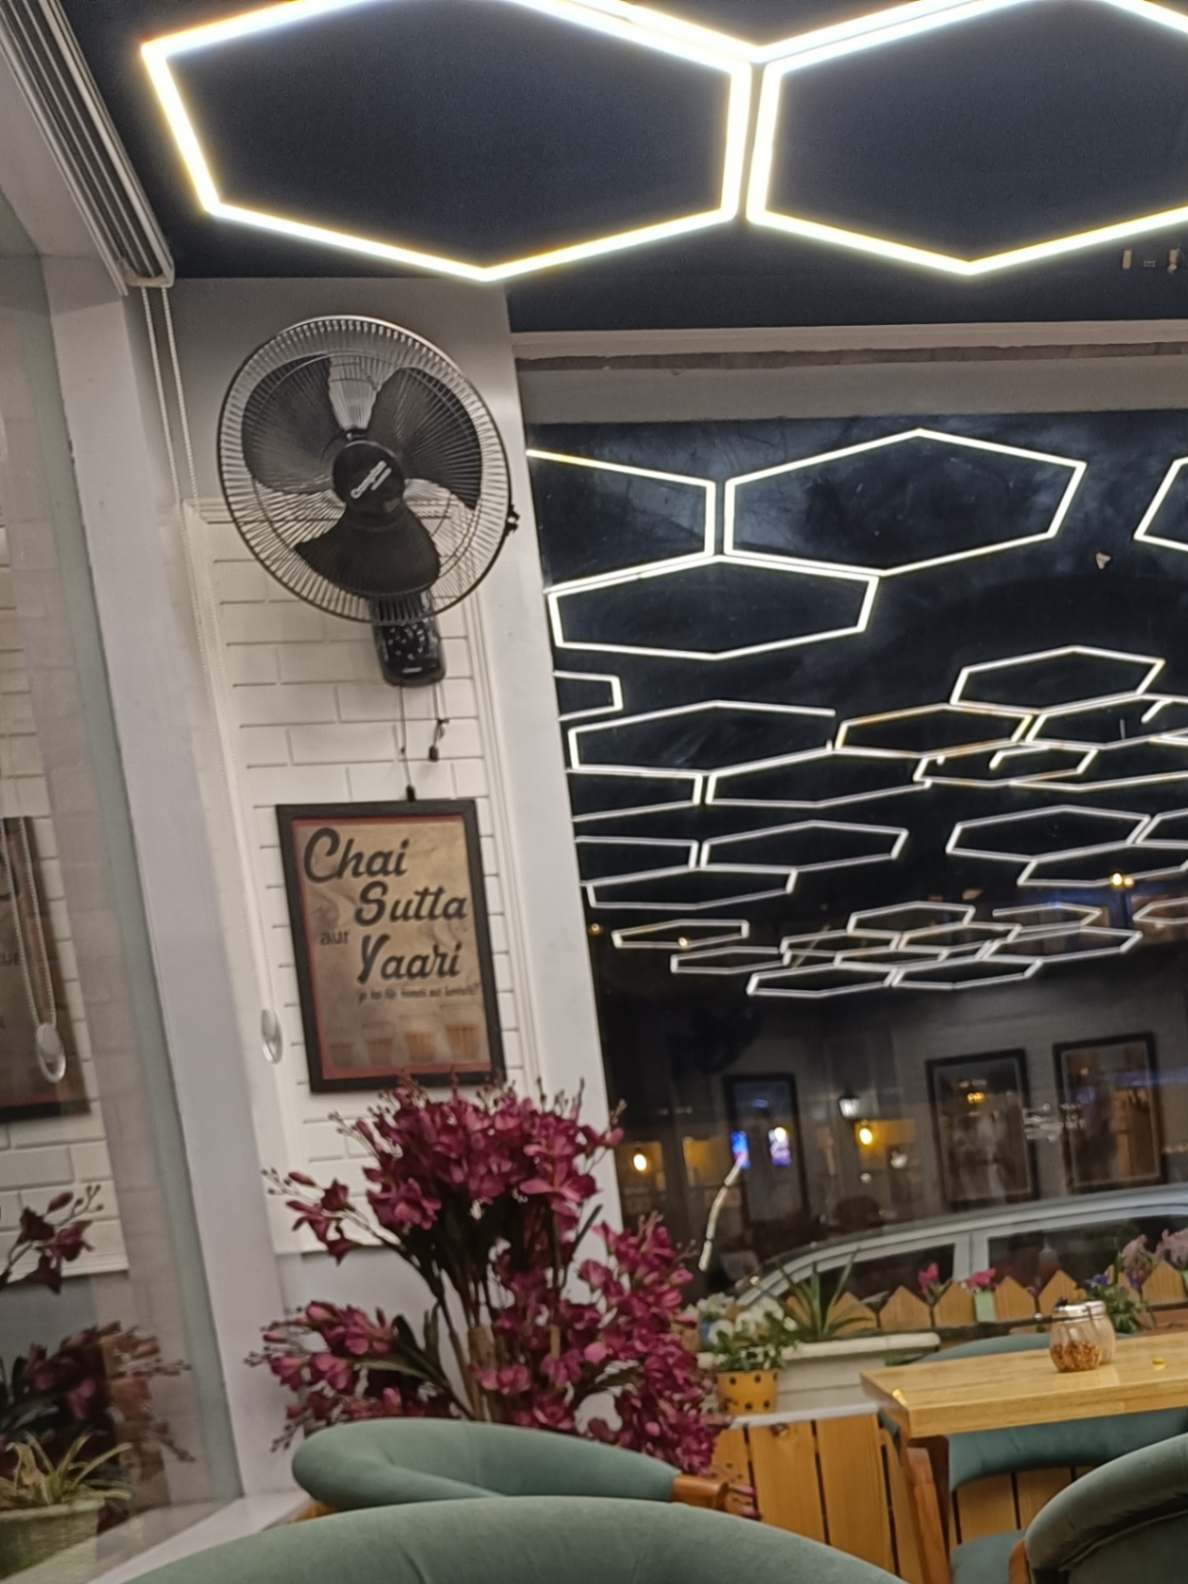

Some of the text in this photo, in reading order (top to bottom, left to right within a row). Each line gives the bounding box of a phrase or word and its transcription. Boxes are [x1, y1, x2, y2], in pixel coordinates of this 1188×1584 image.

[303, 827, 410, 884] Chai
[354, 880, 468, 927] Sutta
[319, 930, 350, 947] aur
[356, 933, 463, 985] Yaari
